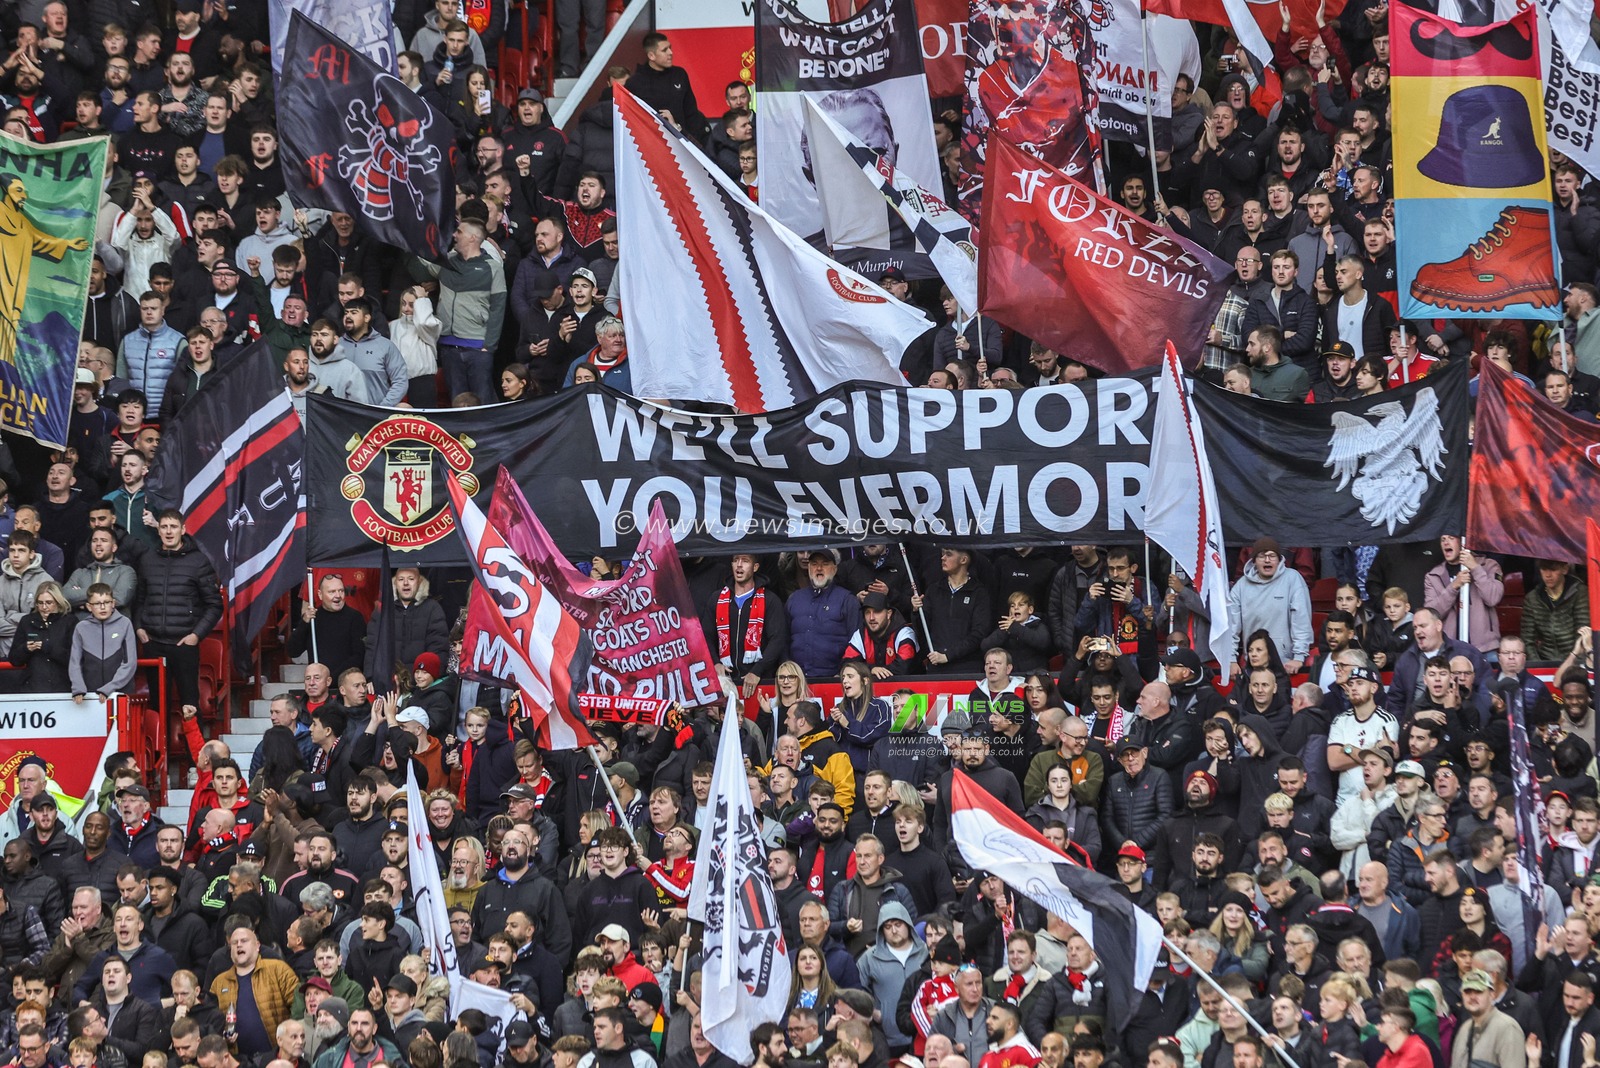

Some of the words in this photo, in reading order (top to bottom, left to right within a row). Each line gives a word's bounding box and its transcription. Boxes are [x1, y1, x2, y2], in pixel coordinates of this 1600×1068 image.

[836, 8, 884, 34] TELL
[799, 59, 825, 78] BE
[1548, 65, 1600, 111] Best
[1544, 86, 1597, 131] Best
[1074, 237, 1124, 269] RED
[1127, 255, 1209, 300] DEVILS
[830, 276, 857, 300] FOOTBALL
[352, 422, 426, 468] MANCHESTER
[429, 429, 467, 467] UNITED
[580, 475, 753, 548] YOU
[773, 462, 1149, 538] EVERMOR
[363, 516, 423, 543] FOOTBALL
[424, 513, 454, 538] CLUB
[648, 607, 681, 635] TOO
[608, 637, 690, 674] MANCHESTER
[633, 661, 719, 709] RULE
[614, 697, 658, 711] UNITED
